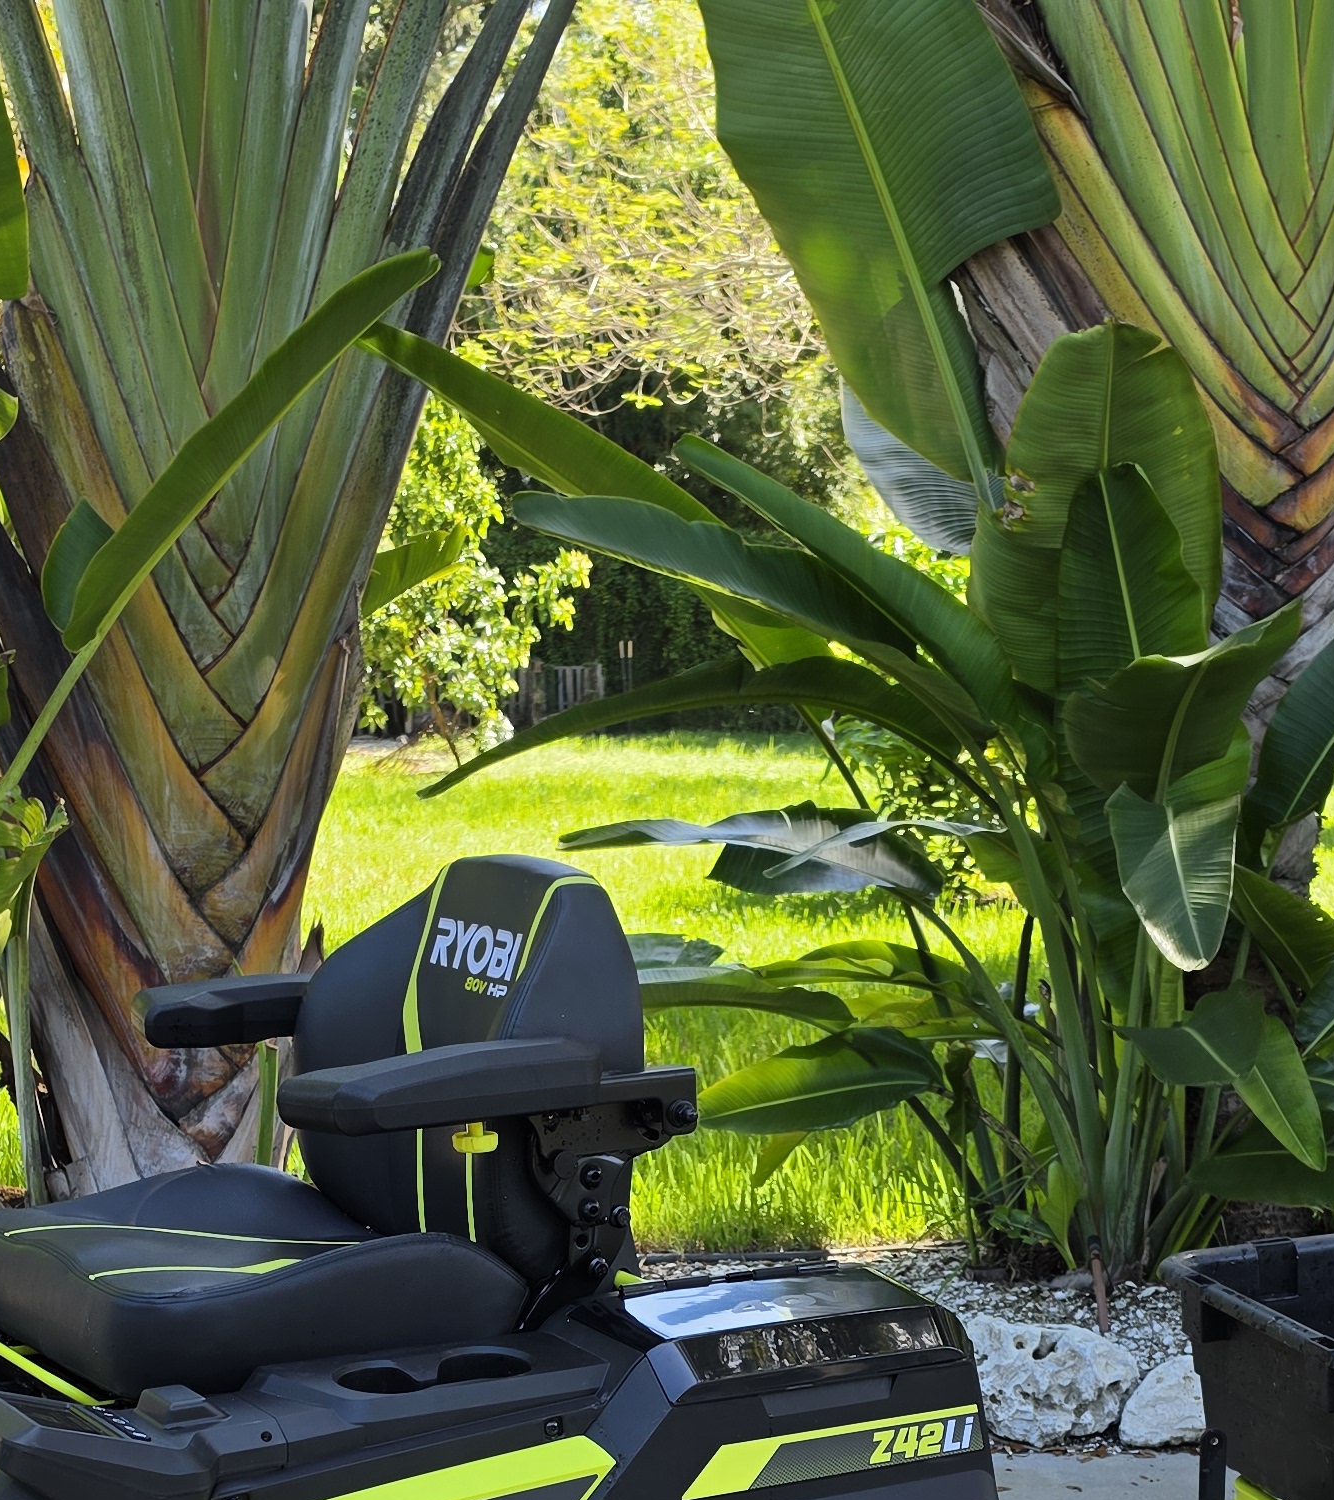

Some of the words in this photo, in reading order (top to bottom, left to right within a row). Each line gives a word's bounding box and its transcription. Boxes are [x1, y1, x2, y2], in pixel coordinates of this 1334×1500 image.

[430, 918, 523, 981] RYOBI
[465, 977, 487, 994] 80V
[487, 983, 508, 997] HP
[869, 1416, 974, 1464] Z42Li
